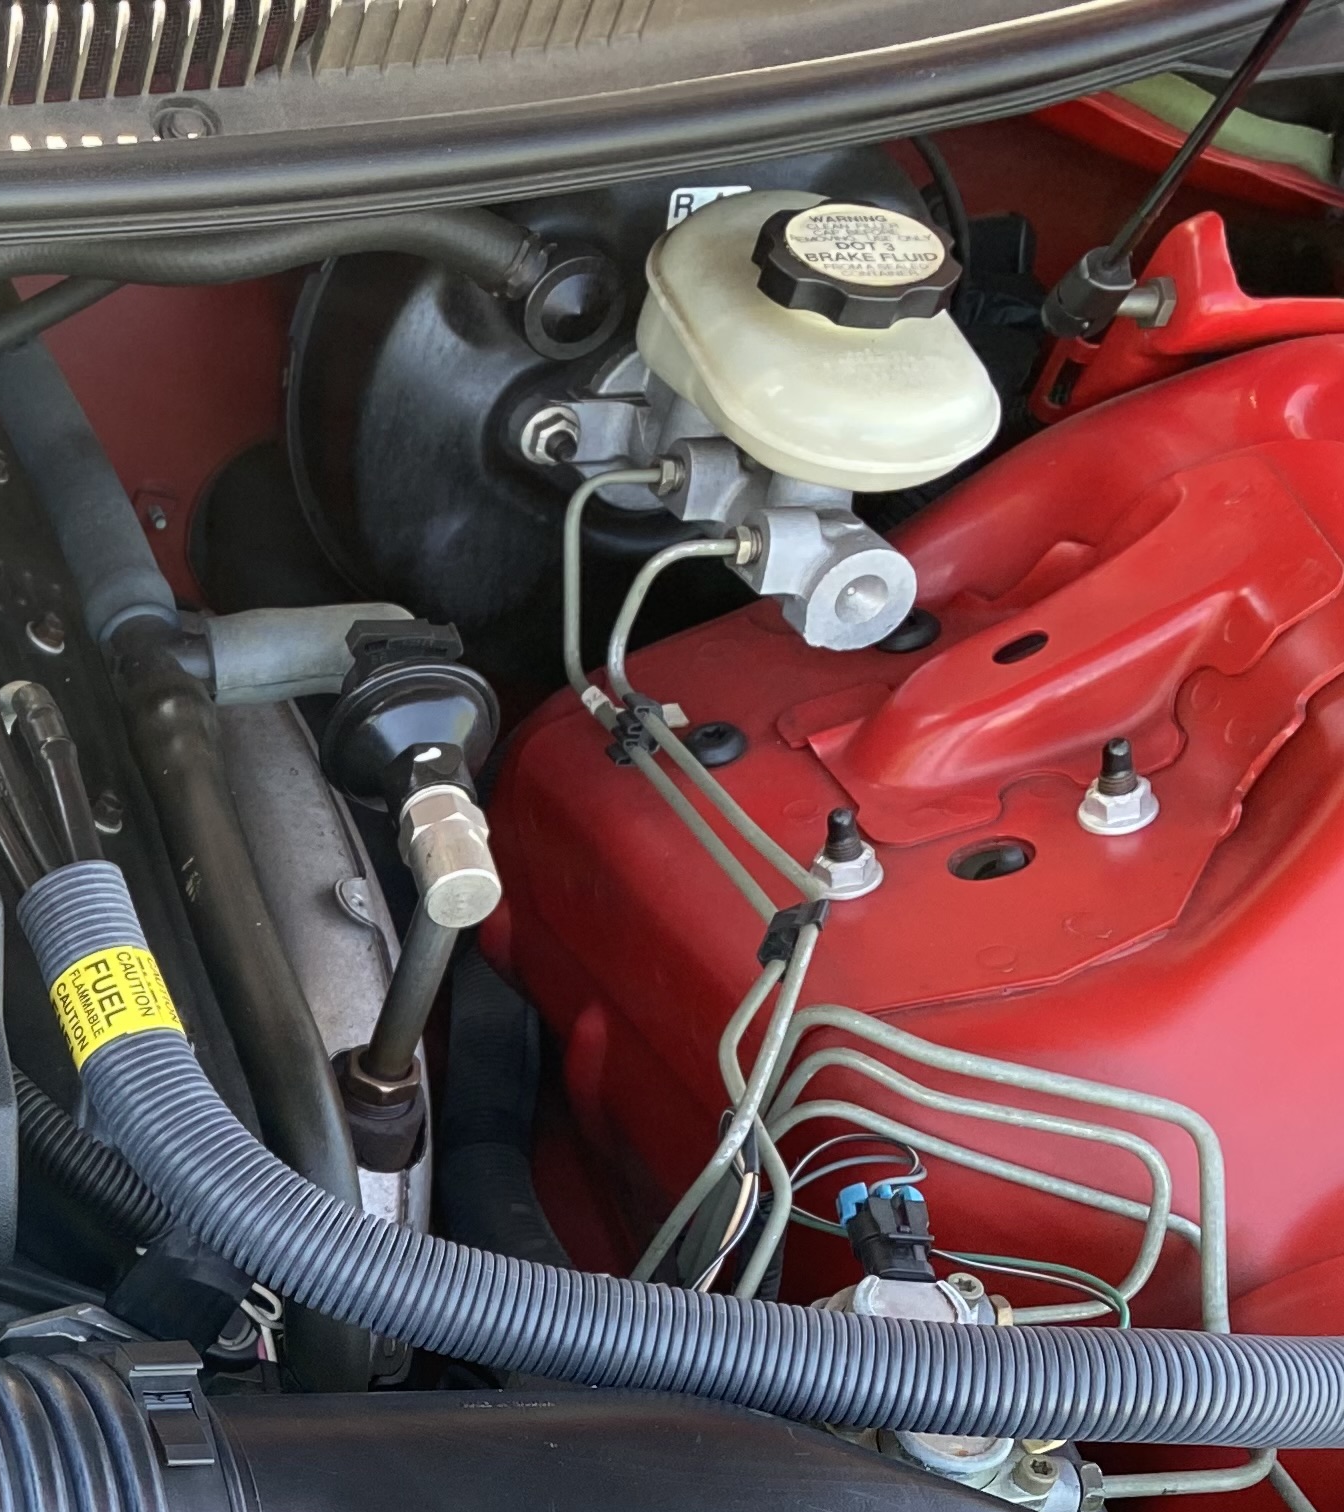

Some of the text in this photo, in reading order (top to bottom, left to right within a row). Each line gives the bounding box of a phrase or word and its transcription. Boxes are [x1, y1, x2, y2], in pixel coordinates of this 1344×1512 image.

[809, 215, 888, 223] WARNING
[836, 242, 896, 252] DOT 3
[804, 252, 939, 263] BRAKE FLUID
[56, 982, 89, 1052] CAUTION
[69, 968, 105, 1039] FLAMMABLE
[85, 958, 127, 1027] FUEL
[117, 951, 155, 1017] CAUTION
